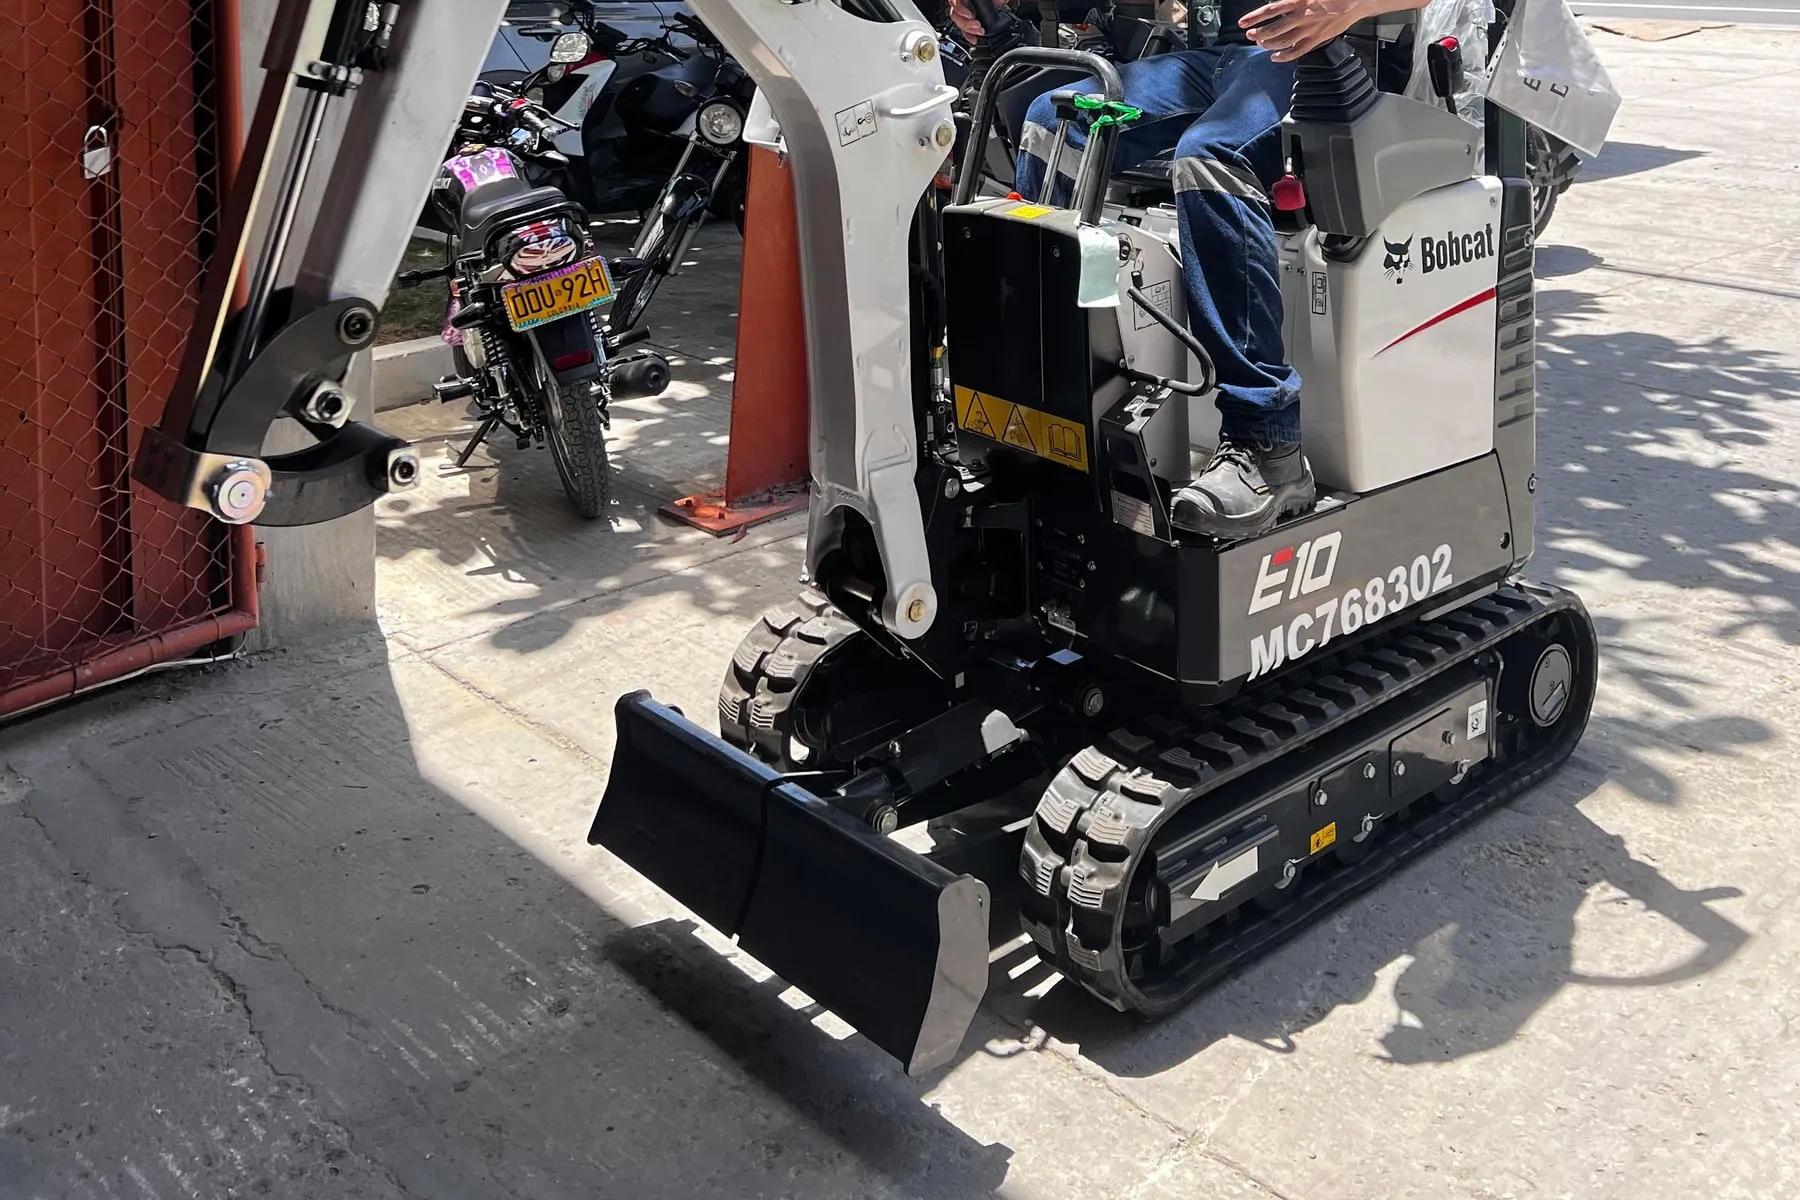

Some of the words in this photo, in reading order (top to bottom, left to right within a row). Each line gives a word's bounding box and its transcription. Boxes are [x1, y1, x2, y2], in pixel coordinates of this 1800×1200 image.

[1421, 223, 1494, 274] Bobcat
[1247, 543, 1453, 682] MC768302
[1248, 531, 1342, 615] E10
